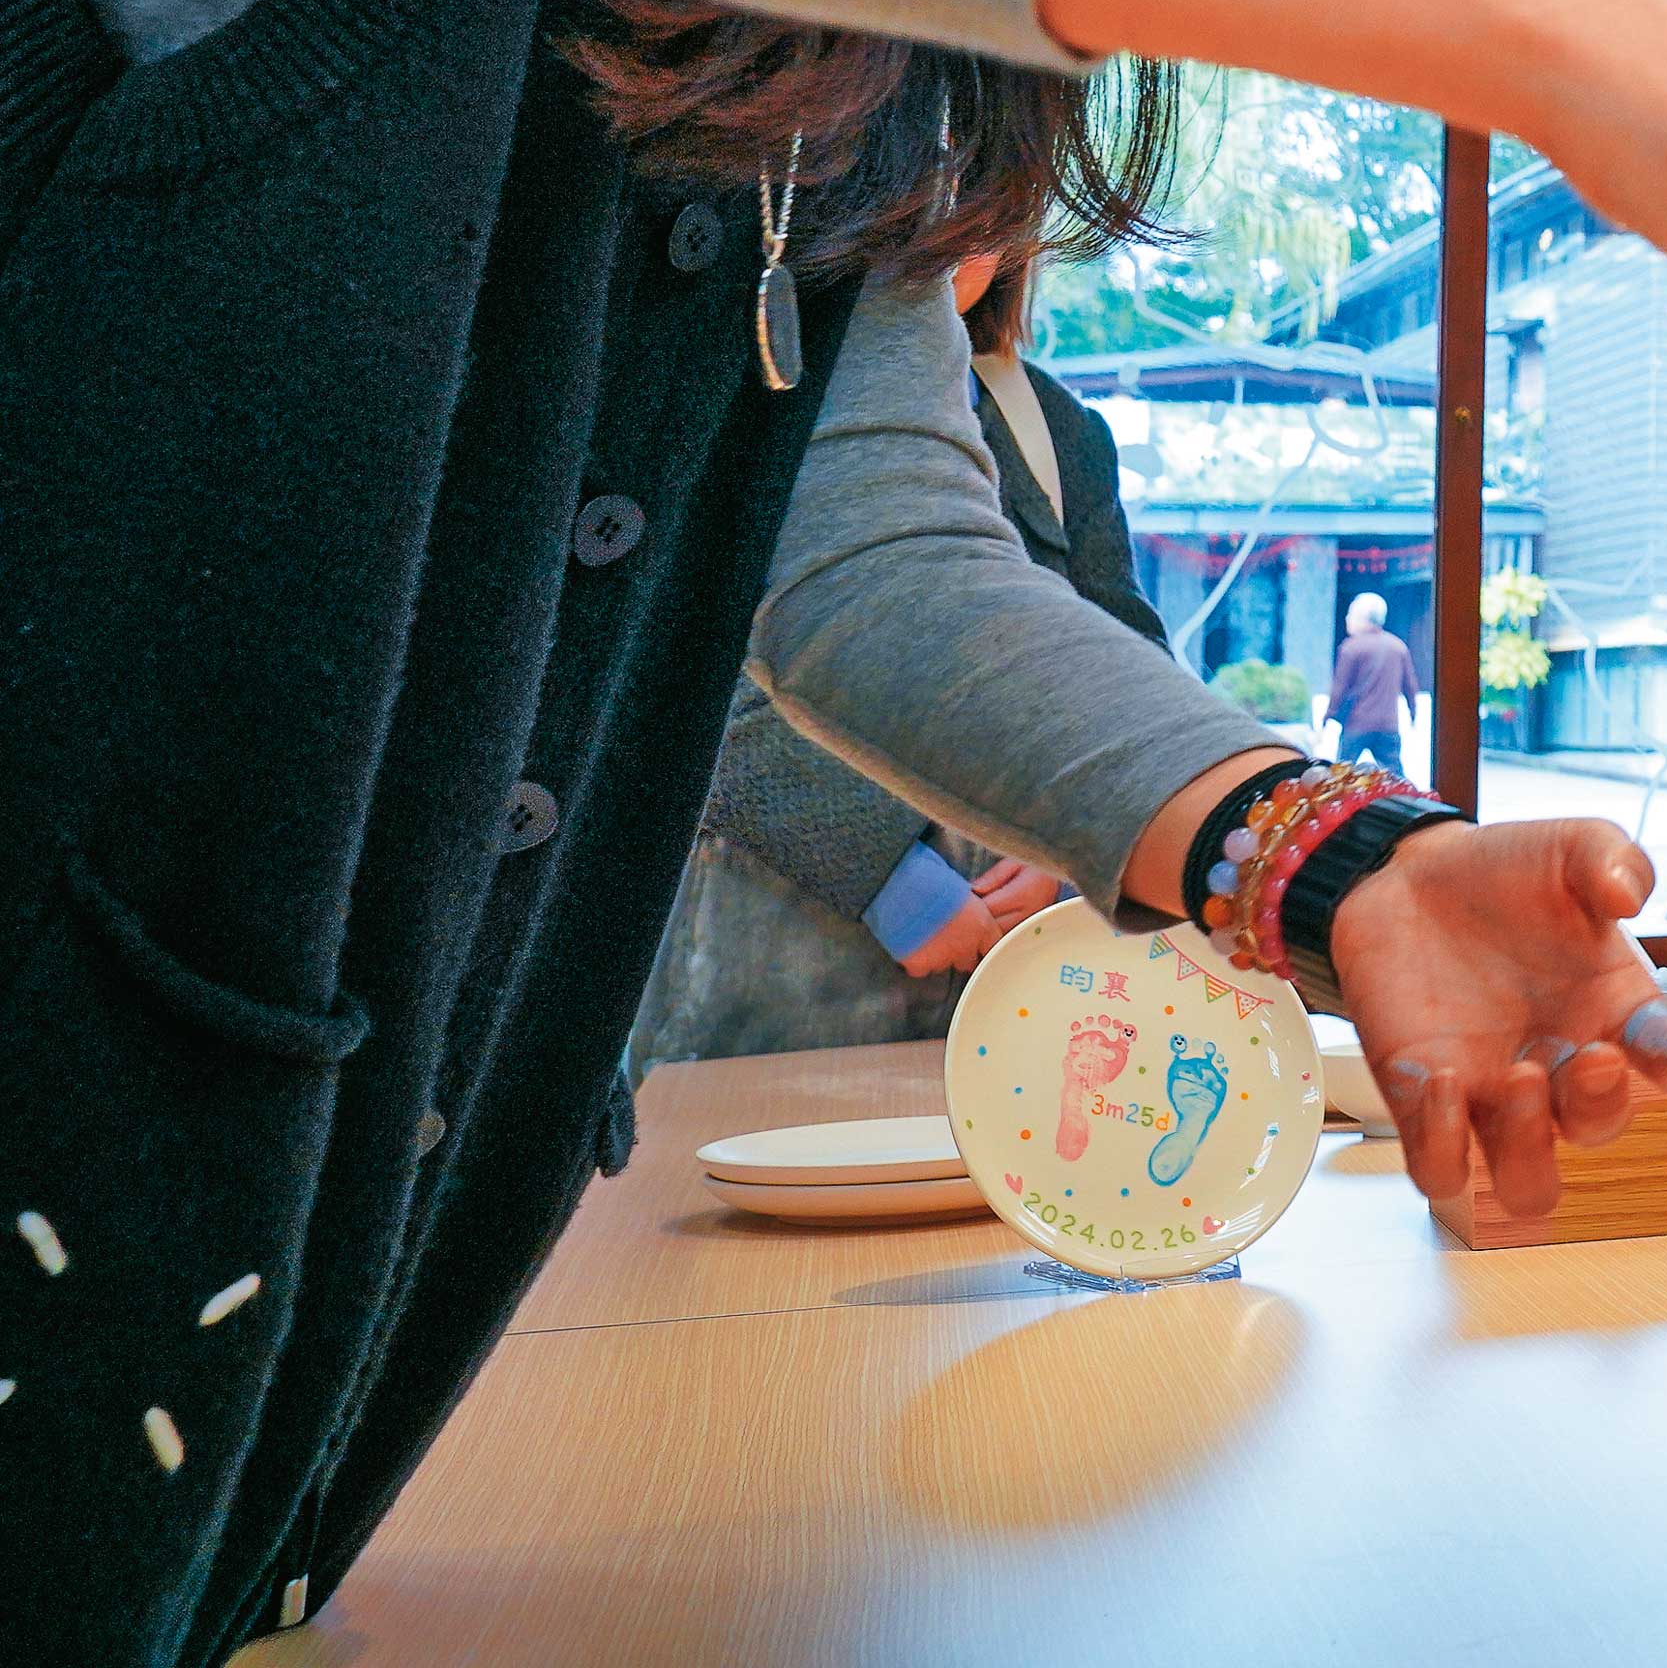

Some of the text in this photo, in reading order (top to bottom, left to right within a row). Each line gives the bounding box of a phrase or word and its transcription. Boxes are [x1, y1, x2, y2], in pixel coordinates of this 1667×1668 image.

[1059, 963, 1132, 1003] 昀襄
[1090, 1093, 1171, 1132] 3m25d
[1023, 1191, 1197, 1252] 2024.02.26
